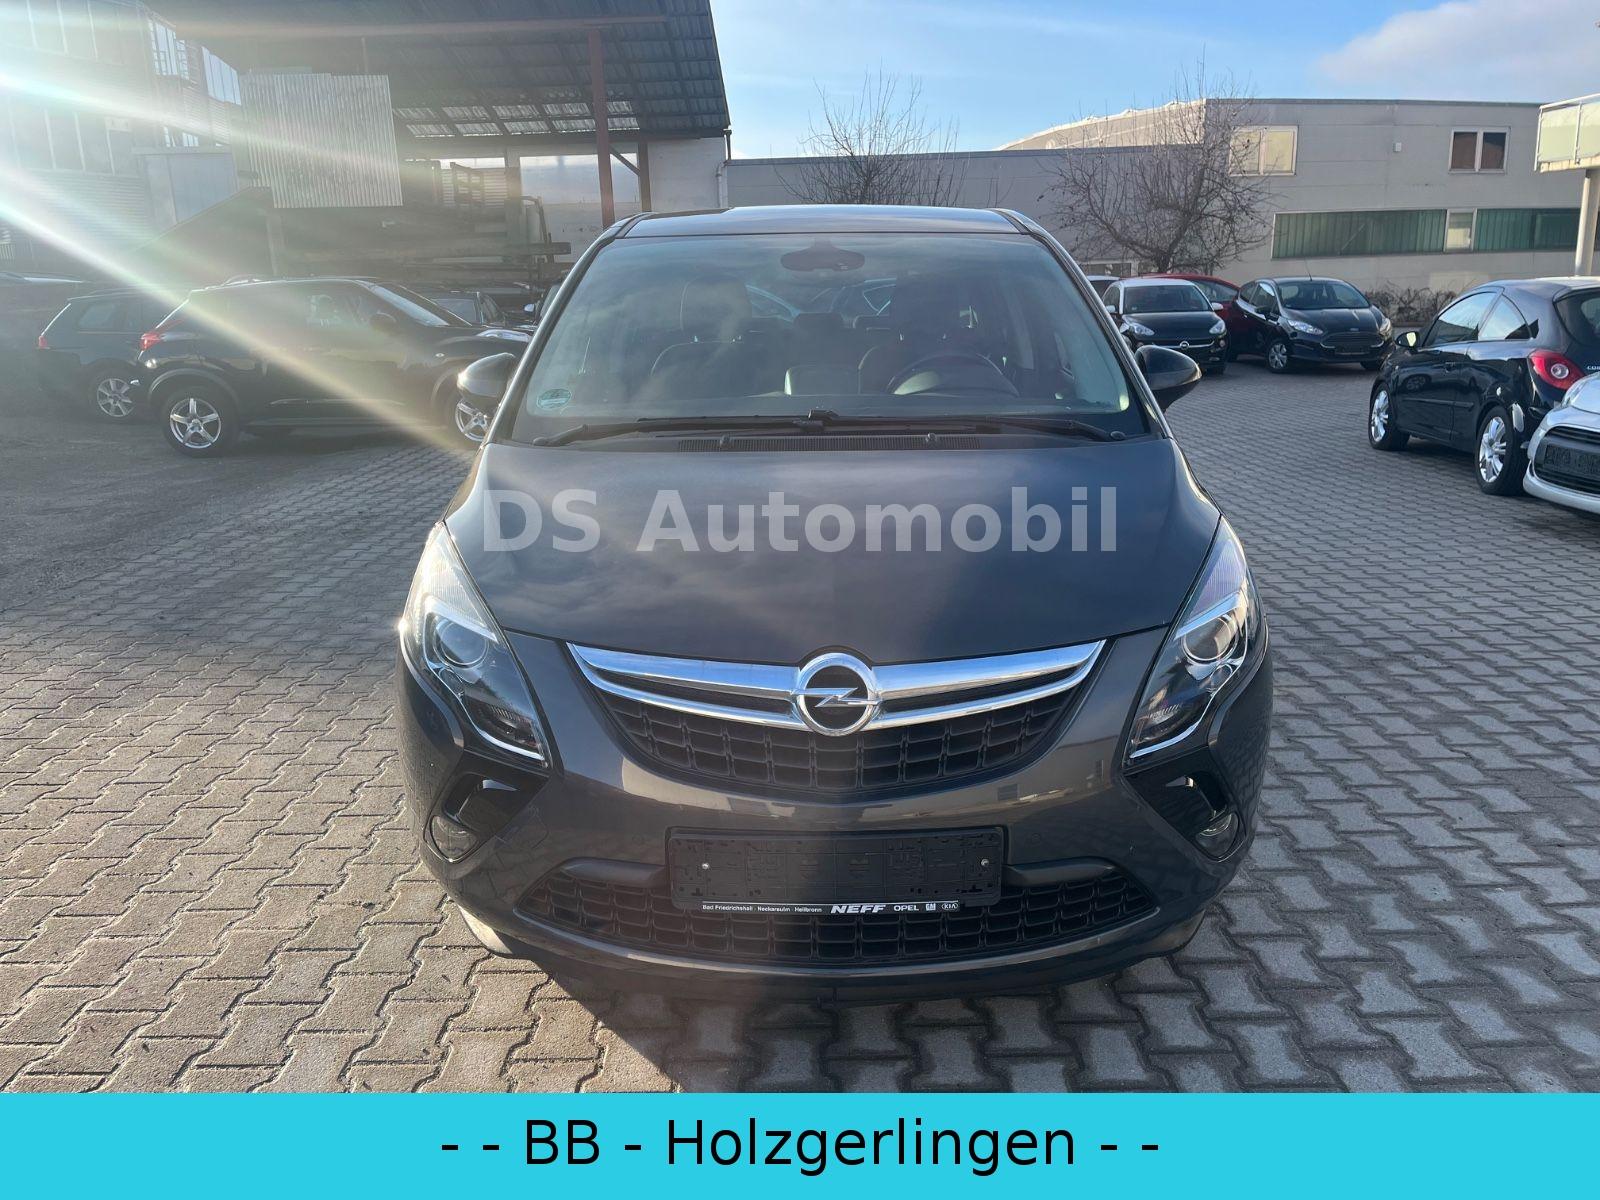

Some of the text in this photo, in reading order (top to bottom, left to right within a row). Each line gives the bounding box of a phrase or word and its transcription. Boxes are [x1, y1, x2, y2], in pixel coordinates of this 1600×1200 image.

[757, 905, 791, 913] Neckarsulm
[830, 904, 887, 914] NEFF
[893, 904, 920, 912] OPEL
